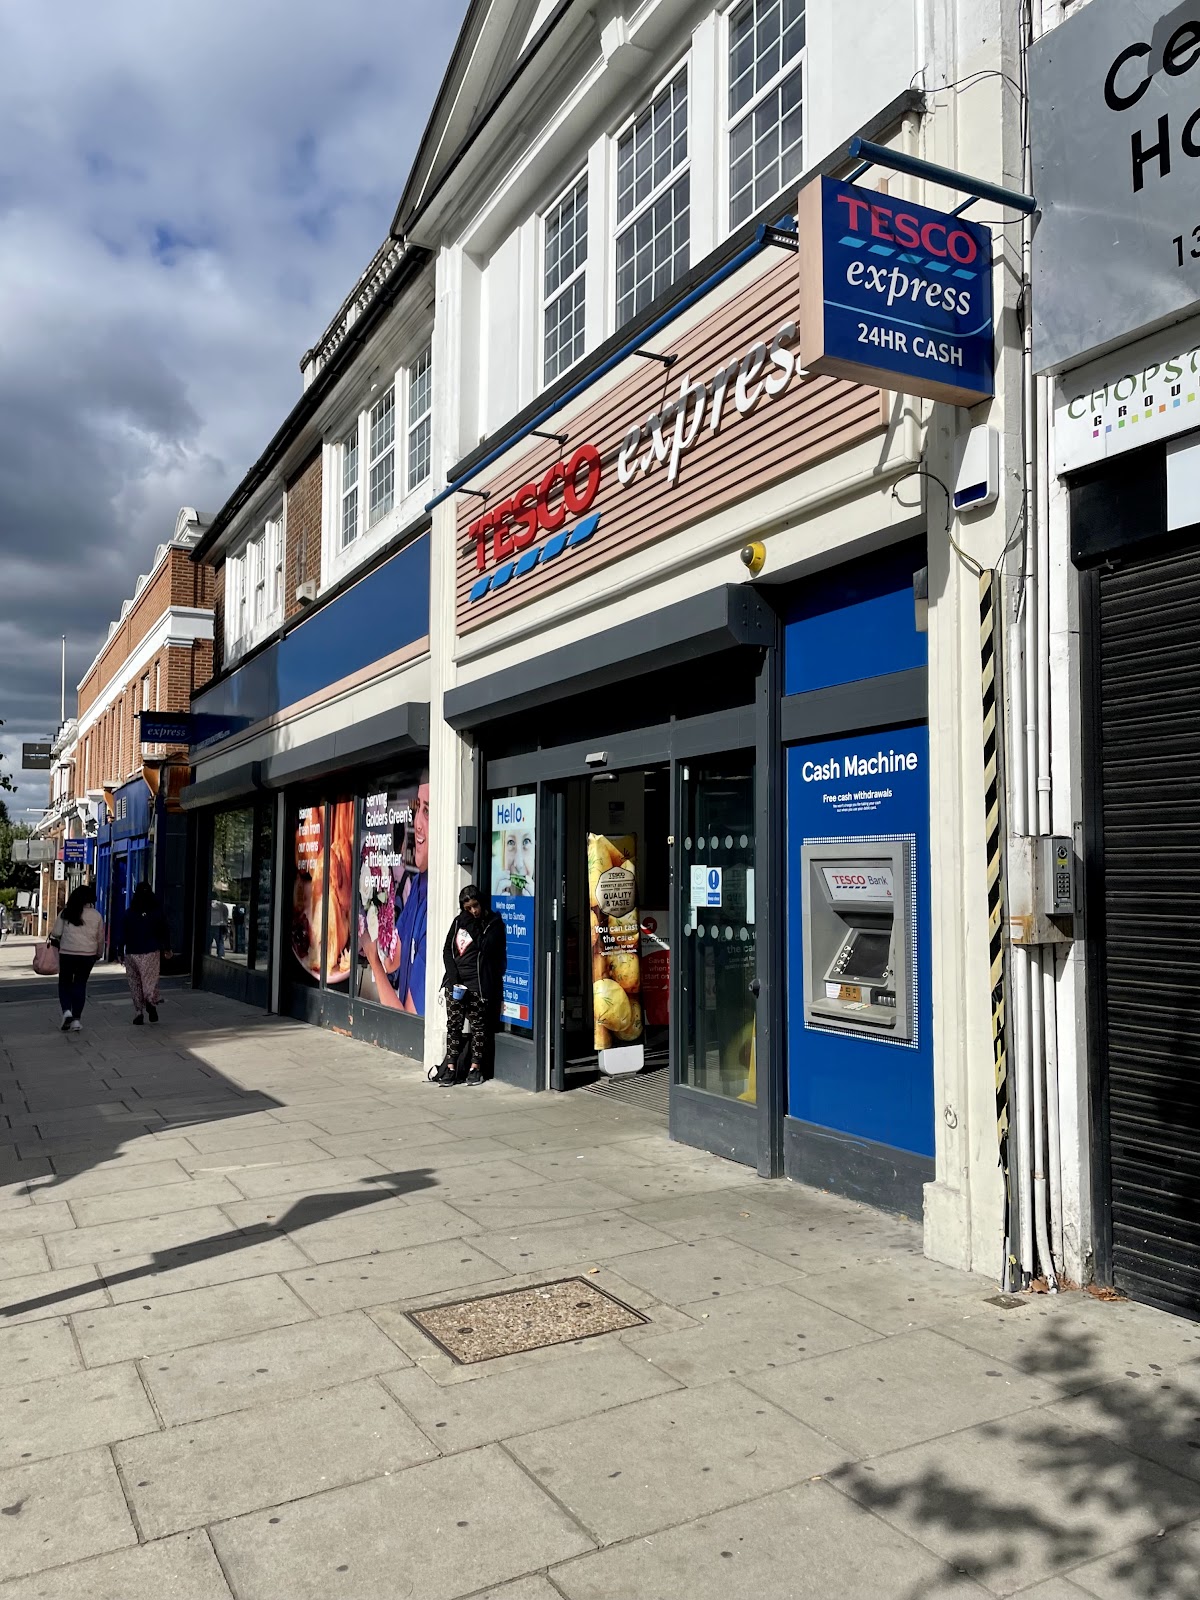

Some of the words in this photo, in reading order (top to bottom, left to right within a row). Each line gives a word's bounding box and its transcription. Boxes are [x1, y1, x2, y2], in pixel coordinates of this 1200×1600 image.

[837, 194, 977, 264] TESCO
[846, 259, 971, 316] express
[857, 322, 908, 354] 24HR
[912, 336, 963, 367] CASH
[468, 444, 602, 571] TESCO
[617, 320, 810, 484] expres
[147, 728, 186, 738] express
[802, 757, 840, 782] Cash
[845, 749, 918, 778] Machine
[366, 791, 388, 808] Serving
[823, 794, 837, 803] Free
[838, 792, 852, 801] cash
[853, 788, 893, 800] withdrawals
[366, 811, 388, 828] Golders
[389, 806, 413, 825] Green's
[497, 802, 525, 825] Hello.
[310, 823, 320, 835] from
[365, 831, 392, 851] shoppers
[365, 855, 369, 867] a
[369, 851, 382, 867] little
[383, 851, 403, 867] better
[364, 875, 380, 892] every
[380, 874, 392, 892] day
[832, 875, 866, 885] TESCO
[867, 875, 889, 886] Bank
[603, 891, 632, 900] QUALITY
[505, 903, 516, 911] open
[611, 899, 630, 907] TASTE
[512, 911, 526, 923] Sunday
[506, 924, 513, 935] to
[512, 924, 527, 938] 11pm
[595, 925, 609, 934] You
[609, 925, 623, 933] can
[624, 923, 639, 931] tast
[602, 934, 616, 943] the
[648, 956, 665, 964] Save
[649, 964, 667, 972] when
[518, 976, 529, 986] Beer
[505, 989, 513, 1001] Top
[512, 991, 519, 1002] Up
